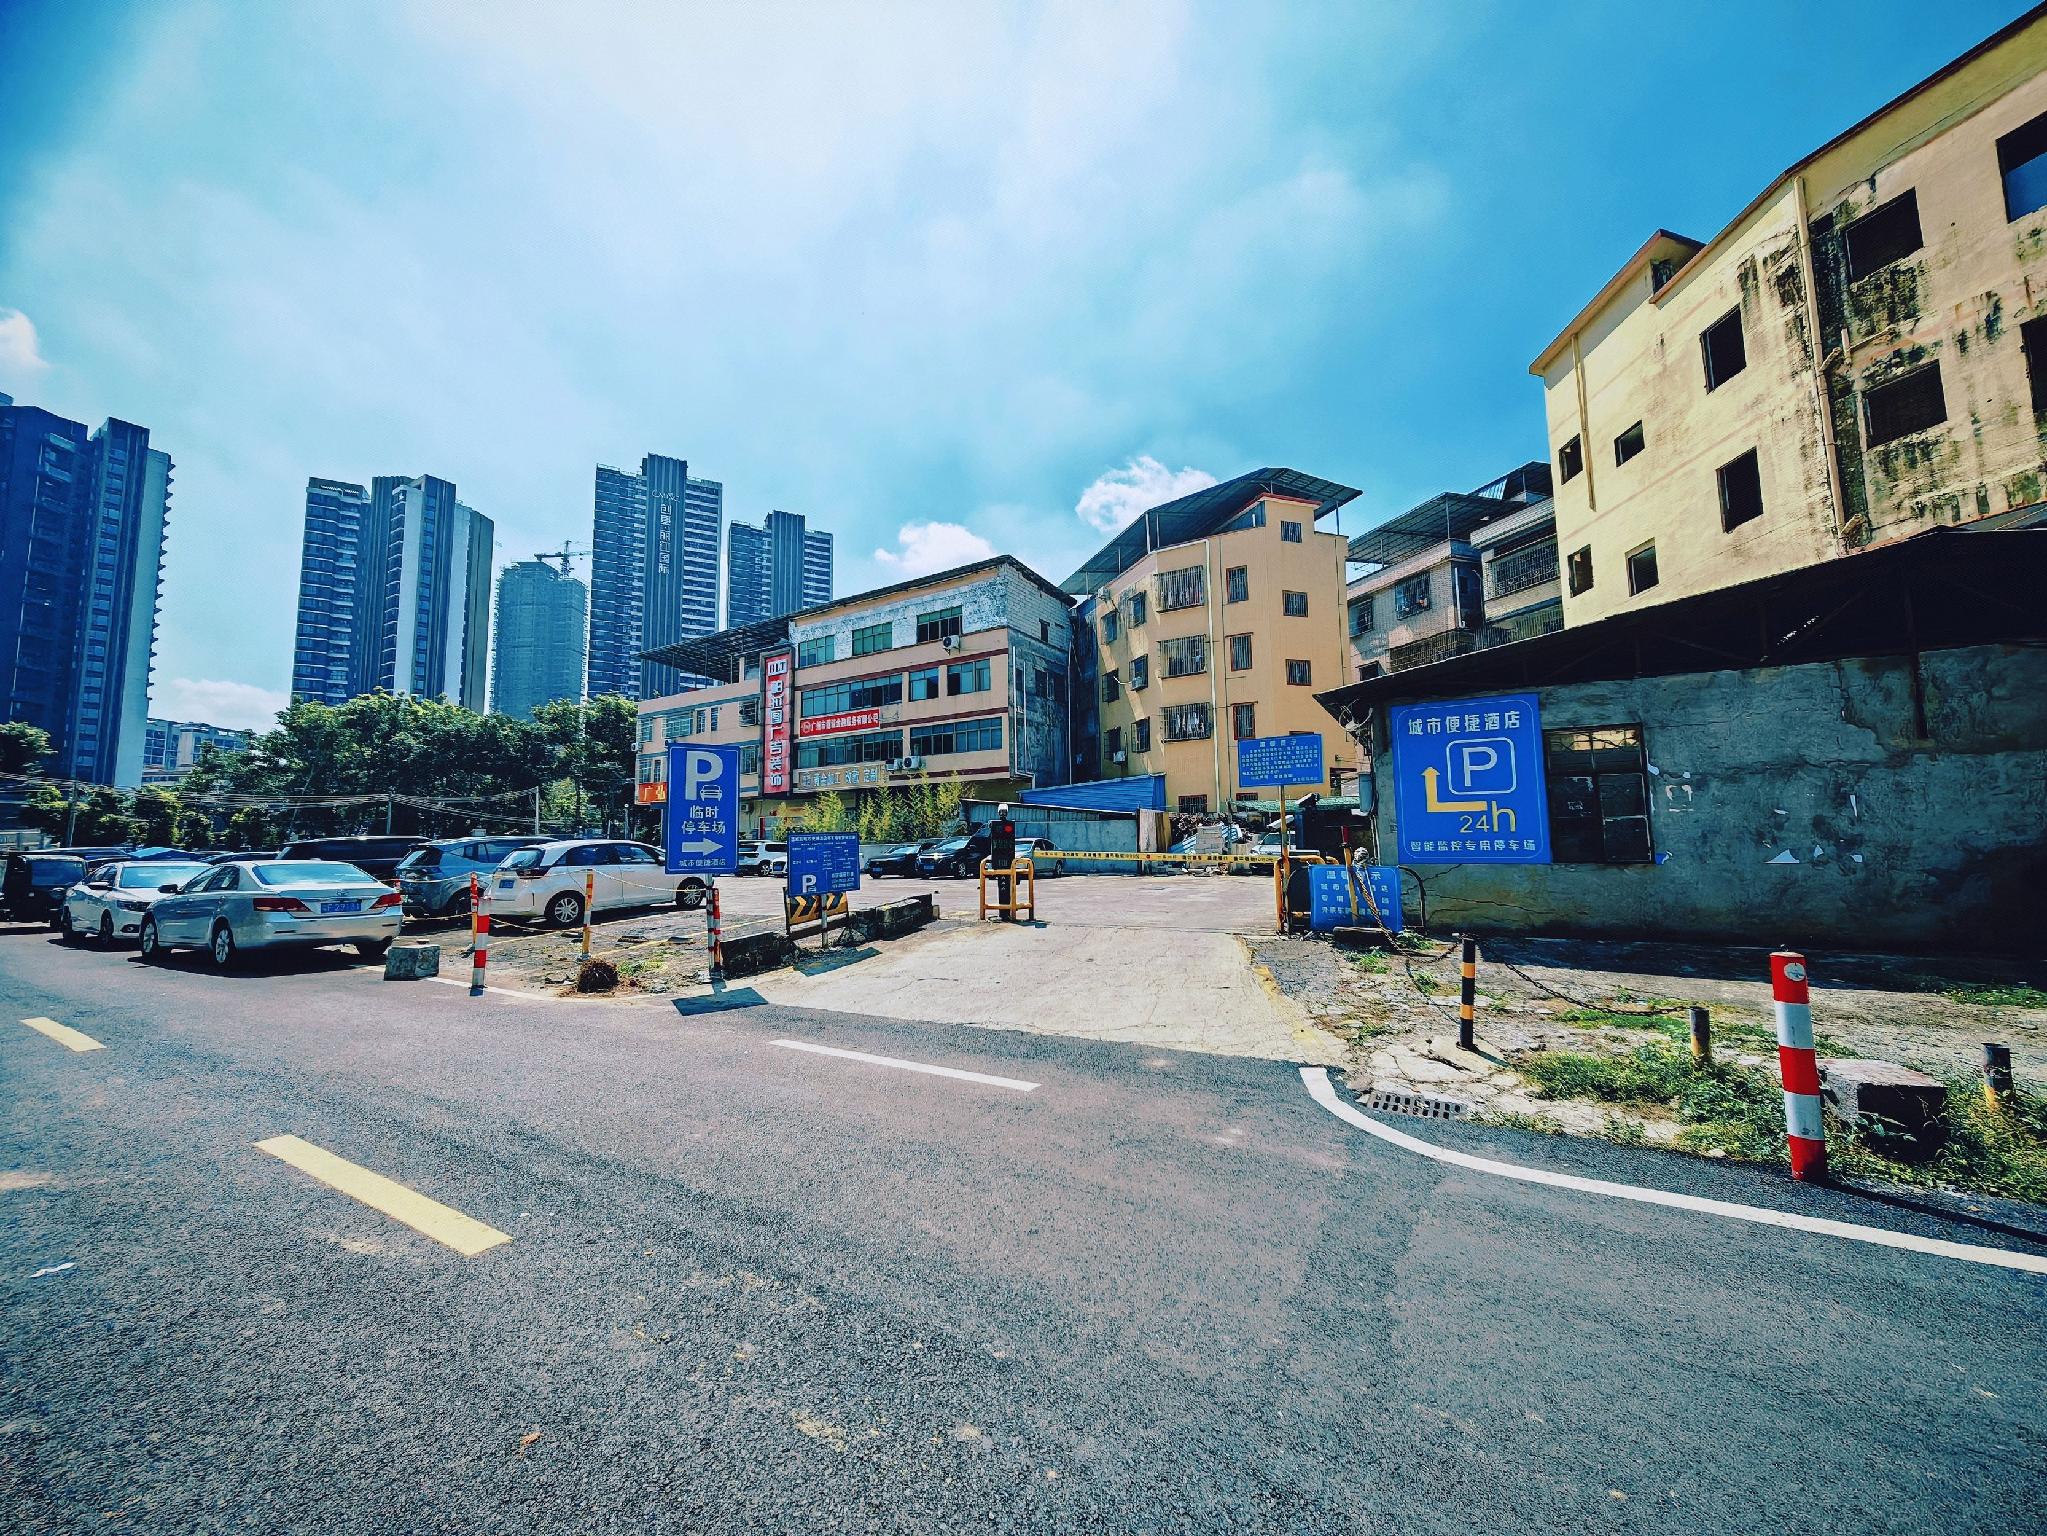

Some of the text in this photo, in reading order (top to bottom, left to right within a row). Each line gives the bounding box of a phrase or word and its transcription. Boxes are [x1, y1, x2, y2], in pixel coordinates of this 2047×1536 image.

[1408, 710, 1521, 735] 城市便捷酒店
[685, 750, 724, 801] P
[1462, 746, 1498, 787] P
[689, 804, 720, 819] 临时
[1459, 800, 1516, 833] 24h
[681, 820, 726, 835] 停车场
[1410, 839, 1536, 852] 智能监控专用停车场
[678, 858, 726, 867] 城市便捷酒店
